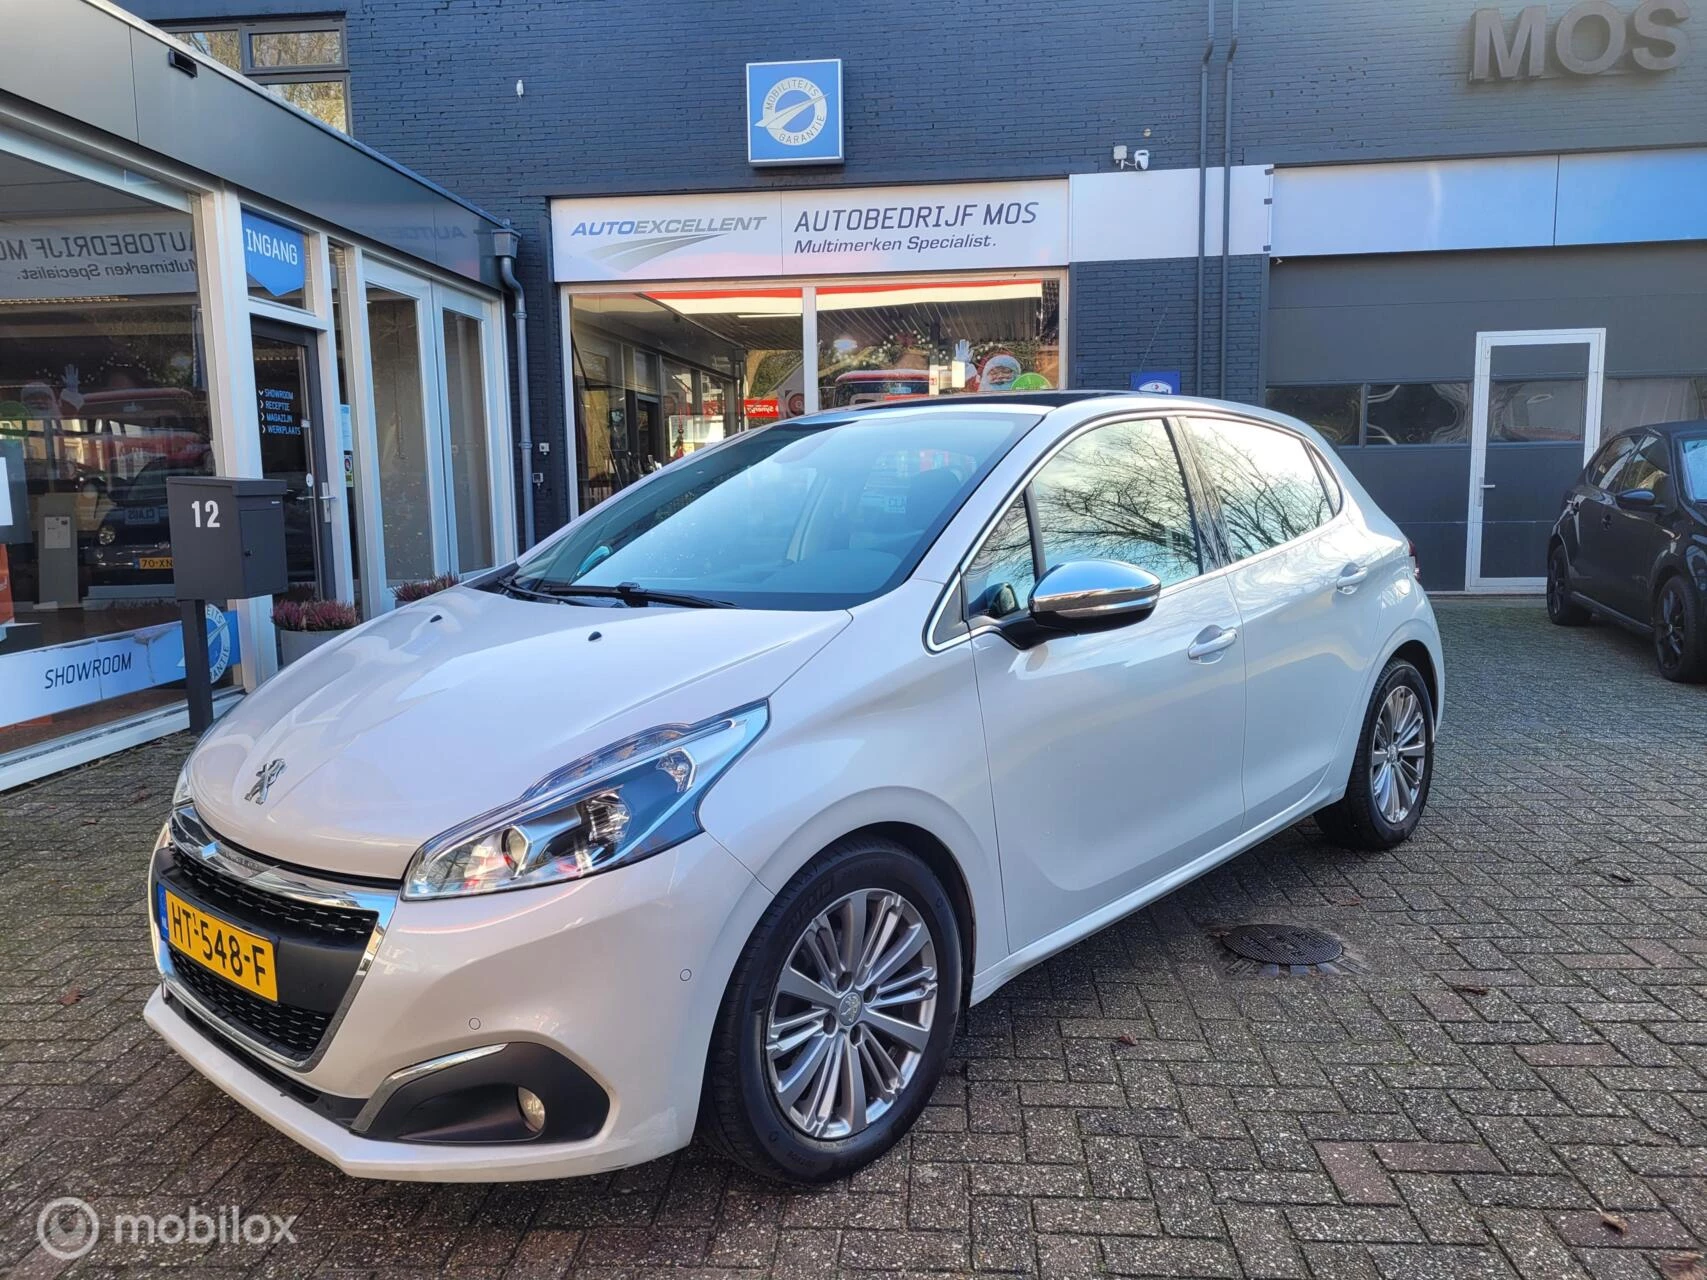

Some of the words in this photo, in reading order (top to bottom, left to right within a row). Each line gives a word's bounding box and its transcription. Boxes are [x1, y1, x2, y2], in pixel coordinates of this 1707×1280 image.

[1471, 0, 1692, 81] MOS
[765, 79, 819, 111] MOBILITEITS
[778, 114, 824, 144] GARANTIE
[571, 216, 767, 236] AUTOEXCELLENT
[794, 204, 978, 233] AUTOBEDRIJF
[983, 201, 1040, 226] MOS
[245, 228, 298, 266] INGANG
[794, 236, 902, 254] Multimerken
[906, 234, 997, 253] Specialist.
[264, 388, 294, 400] SHOWROOM
[265, 400, 290, 412] RECEPTIE
[266, 412, 293, 424] MAGAZIJN
[267, 424, 301, 436] WERKPLAATS
[191, 500, 221, 528] 12
[45, 651, 132, 689] SHOWROOM
[171, 900, 267, 987] HT-548-F
